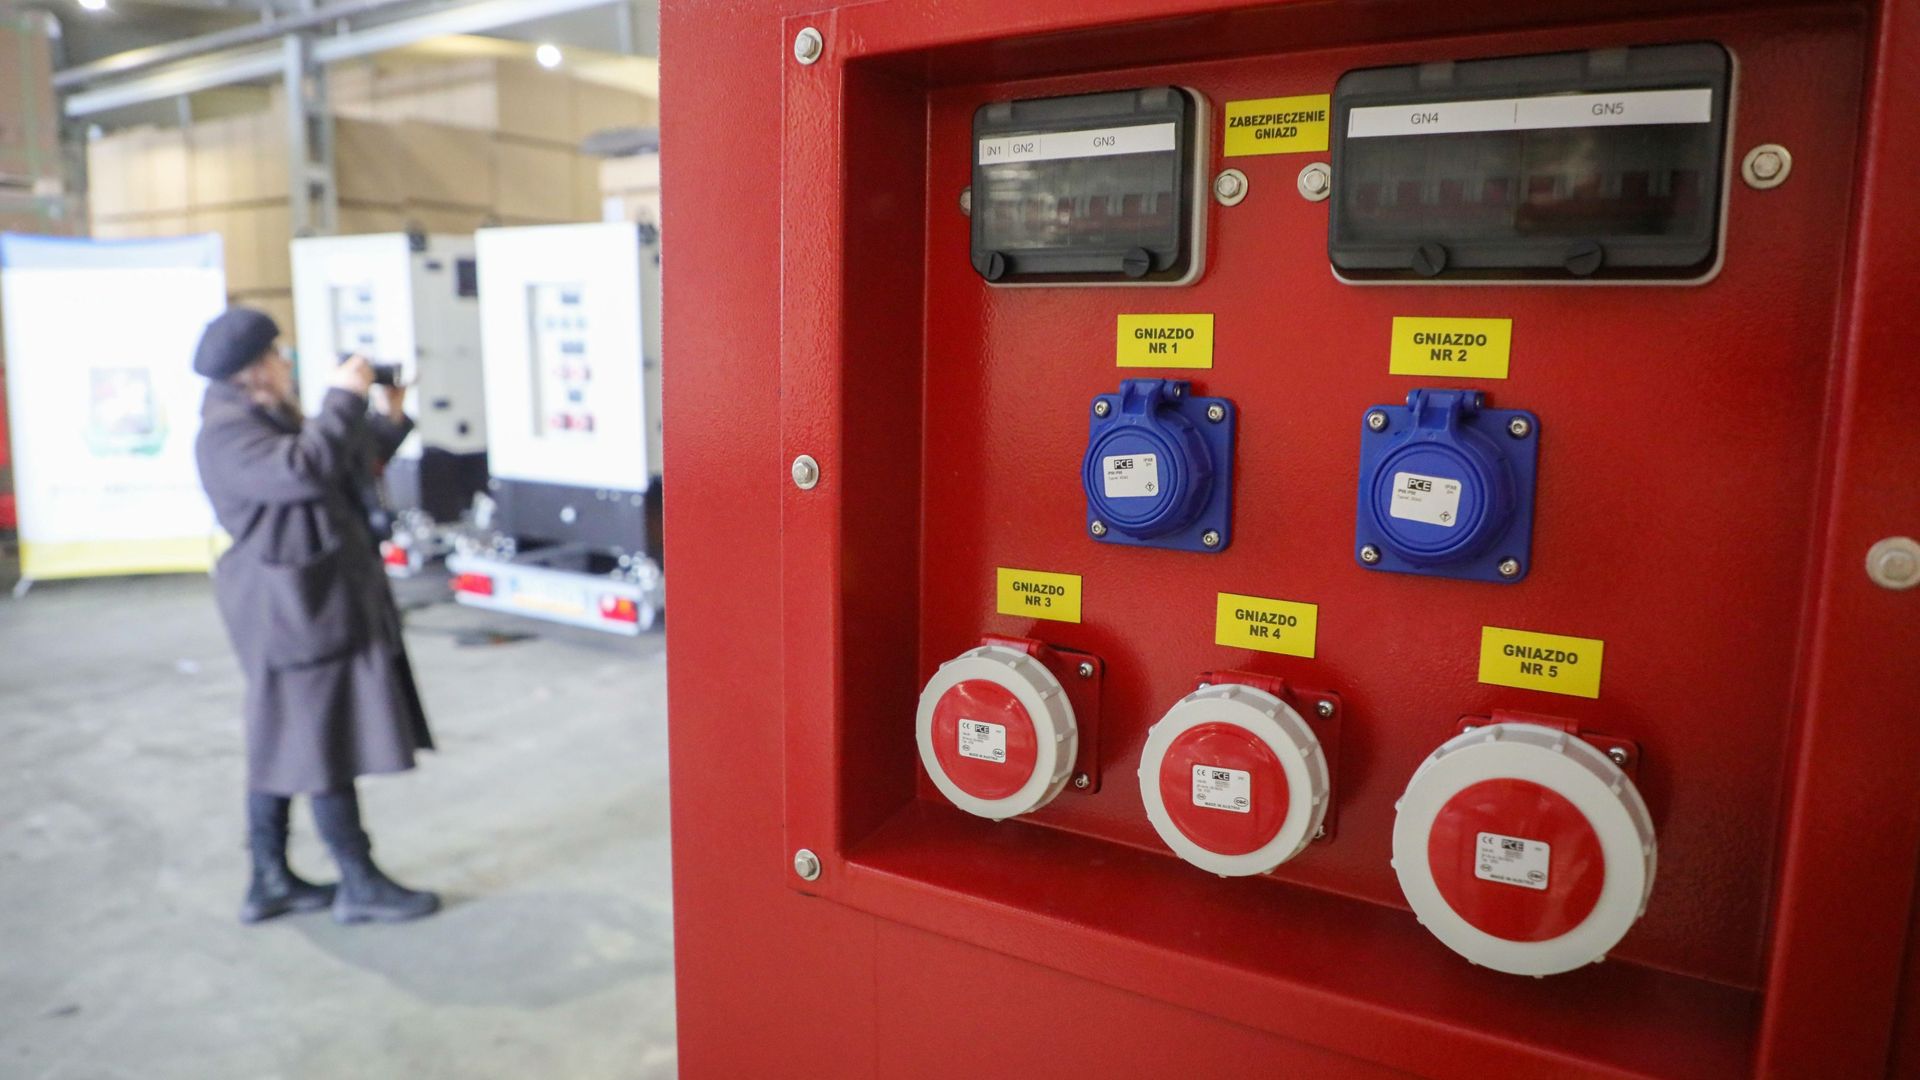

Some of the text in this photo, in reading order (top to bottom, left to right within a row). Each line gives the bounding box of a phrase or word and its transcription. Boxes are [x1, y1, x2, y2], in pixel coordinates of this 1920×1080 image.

[1592, 102, 1624, 116] GN5
[1229, 110, 1325, 128] ZABEZPIECZENIE
[1410, 112, 1439, 125] GN4
[1254, 126, 1298, 140] GNIAZD
[1012, 142, 1034, 154] GN2
[1093, 136, 1116, 147] GN3
[1134, 328, 1195, 340] GNIAZDO
[1413, 332, 1488, 347] GNIAZDO
[1148, 342, 1178, 354] NR 1
[1430, 349, 1468, 362] NR 2
[1114, 459, 1133, 470] PCE
[1408, 478, 1431, 492] PCE
[1012, 581, 1065, 596] GNIAZDO
[1025, 594, 1052, 607] NR 3
[1235, 609, 1297, 627] GNIAZDO
[1249, 624, 1281, 640] NR 4
[1503, 644, 1579, 665] GNIAZDO
[1520, 661, 1558, 678] NR 5
[975, 724, 989, 734] PCE
[1212, 771, 1230, 781] PCE
[1501, 839, 1524, 852] PCE
